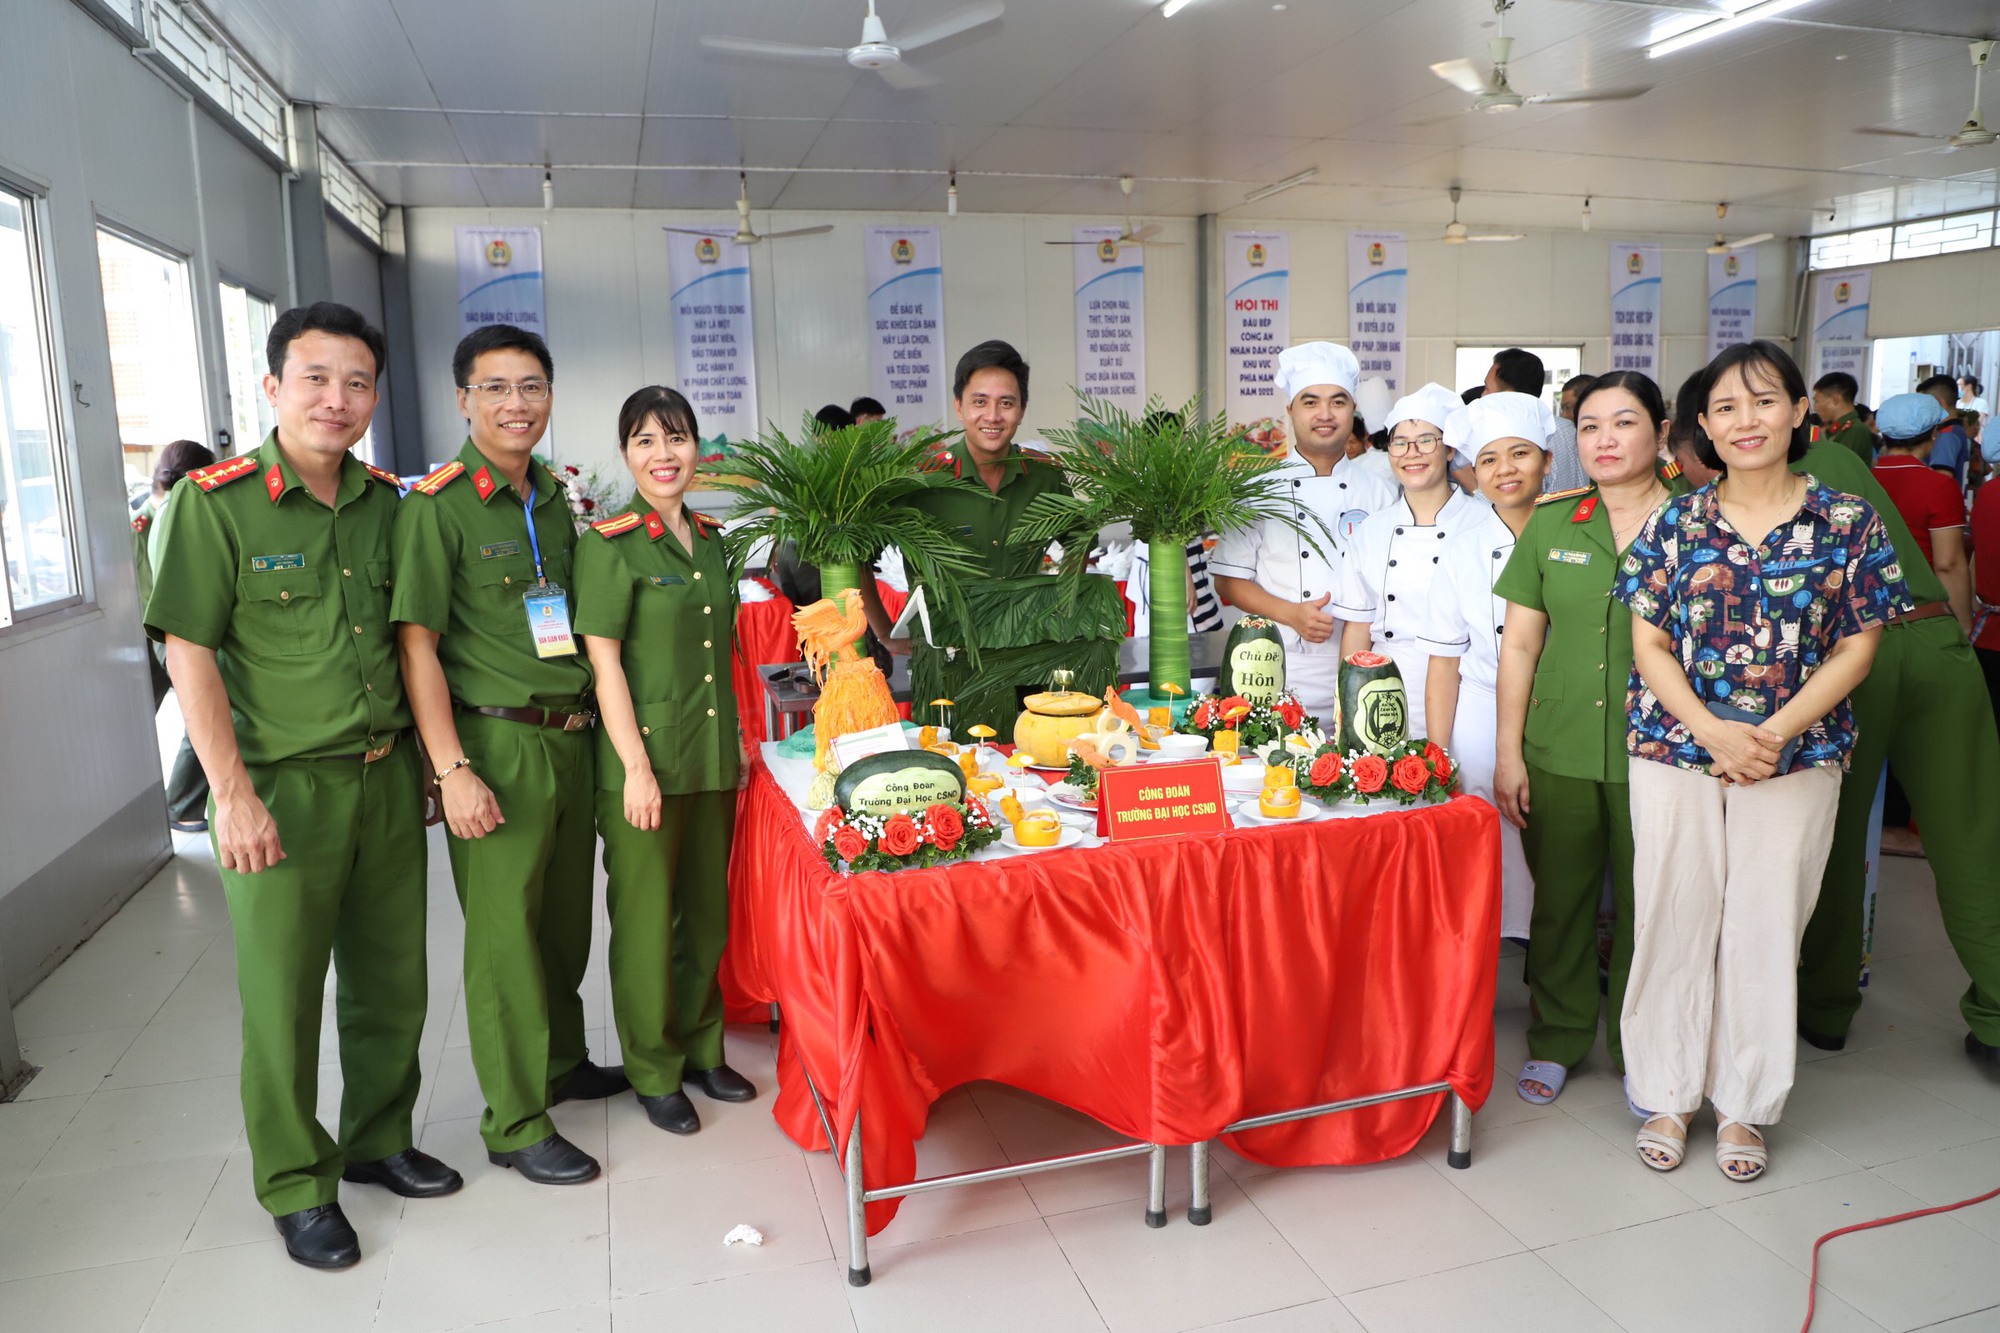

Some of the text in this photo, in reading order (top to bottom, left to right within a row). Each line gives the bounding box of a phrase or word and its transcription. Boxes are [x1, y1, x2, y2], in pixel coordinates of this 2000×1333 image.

[1235, 298, 1279, 312] HỘI THI
[1241, 331, 1273, 341] CÔNG AN
[1230, 345, 1250, 355] NHÂN
[1252, 345, 1267, 355] DÂN
[886, 363, 930, 375] VÀ TIÊU DÙNG
[1242, 359, 1271, 369] KHU VỰC
[890, 376, 927, 391] THỰC PHẨM
[1240, 373, 1274, 382] PHÍA NAM
[1240, 386, 1274, 396] NĂM 2022
[896, 392, 923, 404] AN TOÀN
[1241, 672, 1275, 687] Hồn
[885, 782, 909, 792] Công
[1138, 784, 1191, 801] CÔNG ĐOÀN
[858, 790, 958, 806] Trường Đại Học CSND
[1116, 802, 1217, 823] TRƯỜNG ĐẠI HỌC CSND
